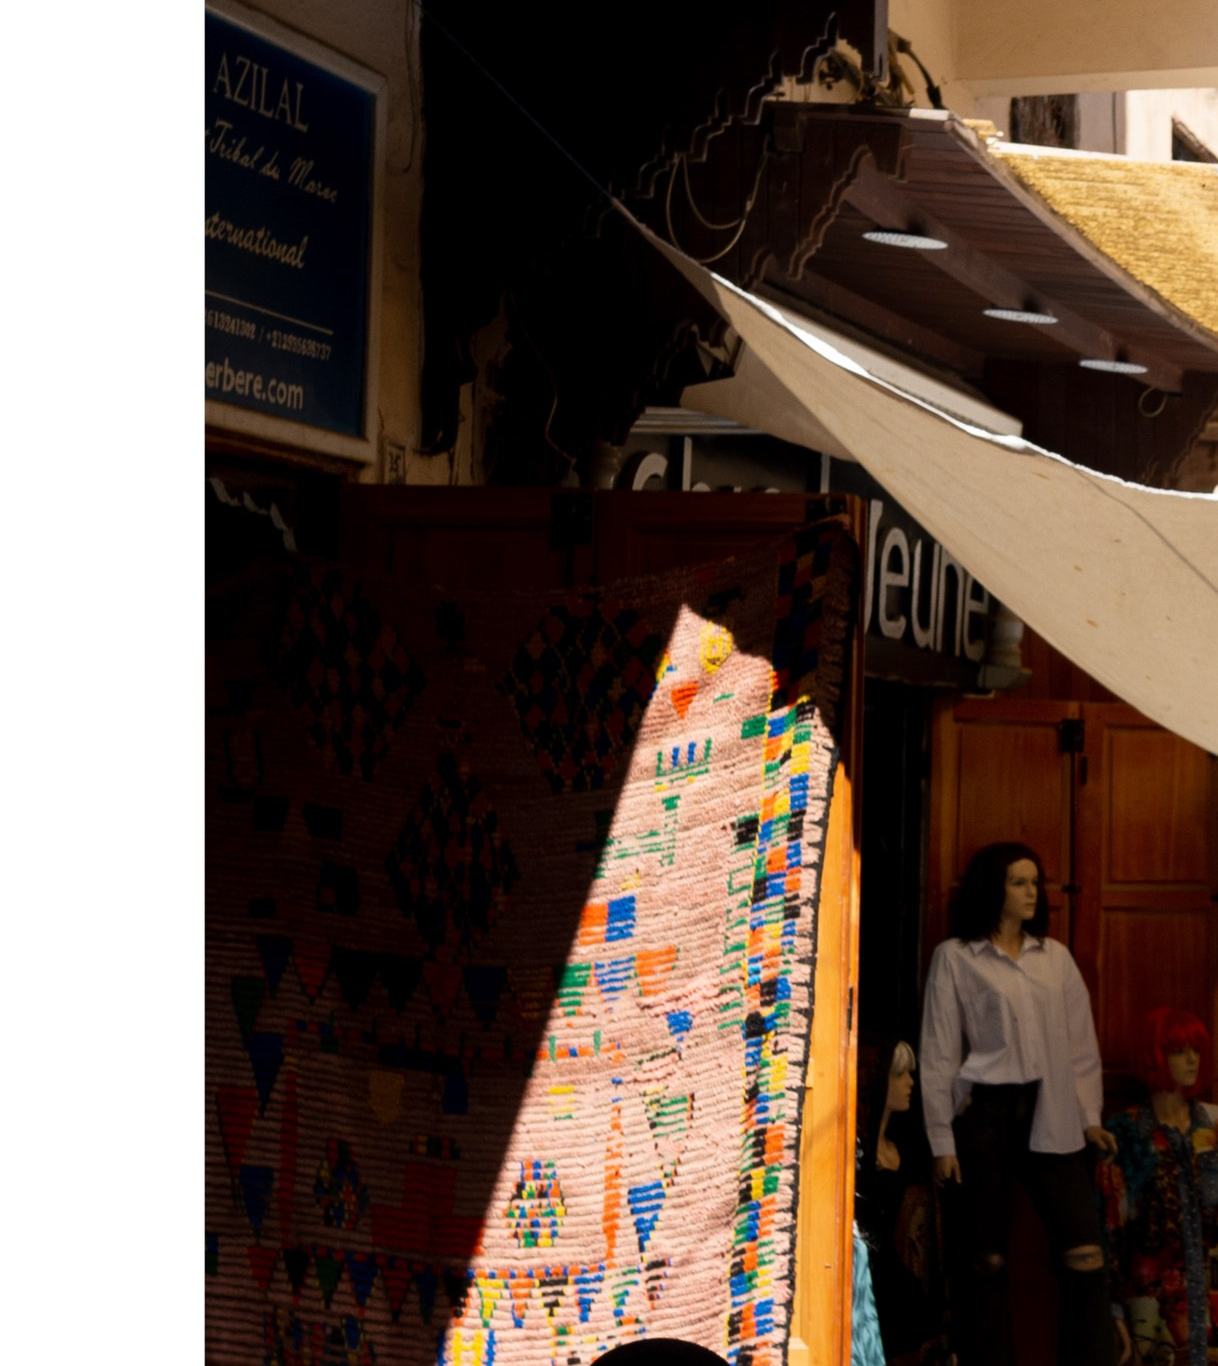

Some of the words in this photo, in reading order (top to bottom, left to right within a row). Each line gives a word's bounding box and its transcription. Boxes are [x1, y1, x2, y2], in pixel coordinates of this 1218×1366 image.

[212, 52, 309, 133] AZILAL
[209, 117, 265, 169] Tribal
[258, 149, 280, 181] du
